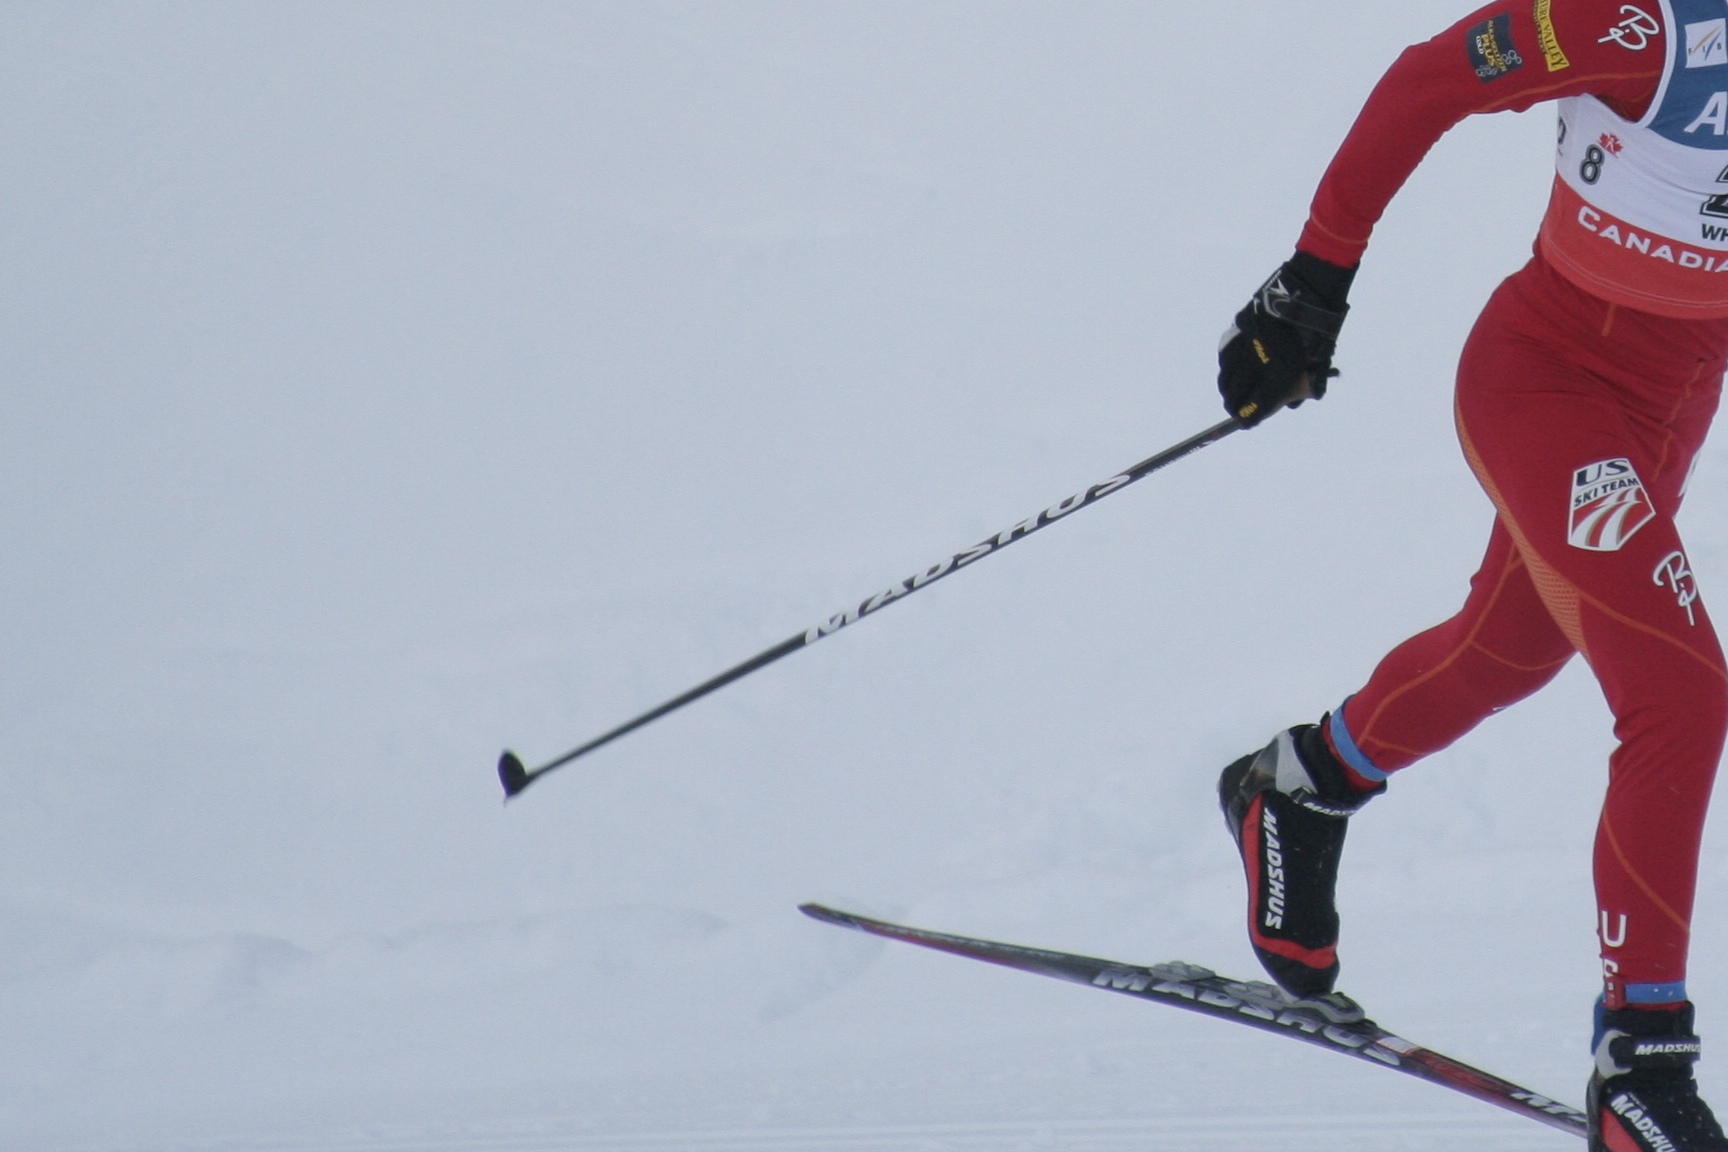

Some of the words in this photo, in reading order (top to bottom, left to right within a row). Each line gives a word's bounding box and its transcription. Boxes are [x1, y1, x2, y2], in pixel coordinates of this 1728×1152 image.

[1481, 34, 1498, 67] PLUS
[1543, 24, 1568, 68] VALLEY
[1575, 459, 1629, 487] US
[1574, 487, 1599, 508] SKI
[1601, 477, 1640, 494] TEAM
[805, 474, 1132, 646] MADSHUS
[1262, 806, 1286, 930] MADSHUS
